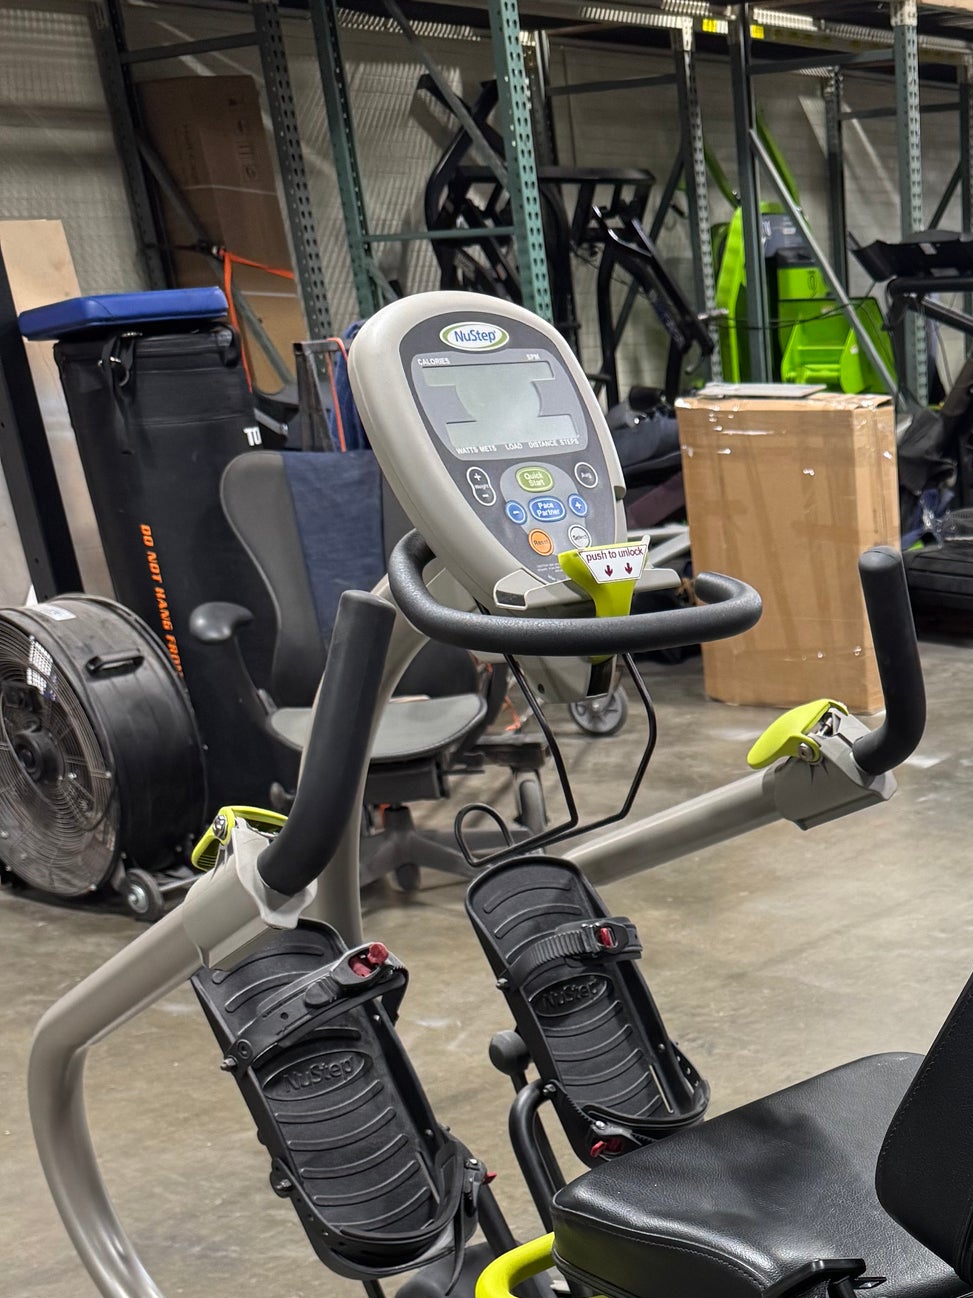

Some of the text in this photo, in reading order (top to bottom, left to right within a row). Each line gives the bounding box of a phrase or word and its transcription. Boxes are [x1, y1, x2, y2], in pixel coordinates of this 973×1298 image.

[454, 330, 496, 343] NuStep
[417, 358, 451, 366] CALORIES
[456, 446, 479, 454] WATTS
[480, 445, 497, 453] METS
[528, 440, 559, 448] DISTANCE
[560, 438, 580, 446] STEPS
[523, 472, 543, 481] Quick
[529, 479, 546, 487] Start
[536, 509, 560, 517] Partner
[537, 502, 554, 510] Pace
[139, 524, 154, 547] DO
[586, 546, 644, 563] push to unlock
[147, 551, 163, 583] NOT
[154, 587, 174, 631] HANG
[542, 978, 600, 1010] NuStep
[282, 1055, 354, 1094] NuStep
